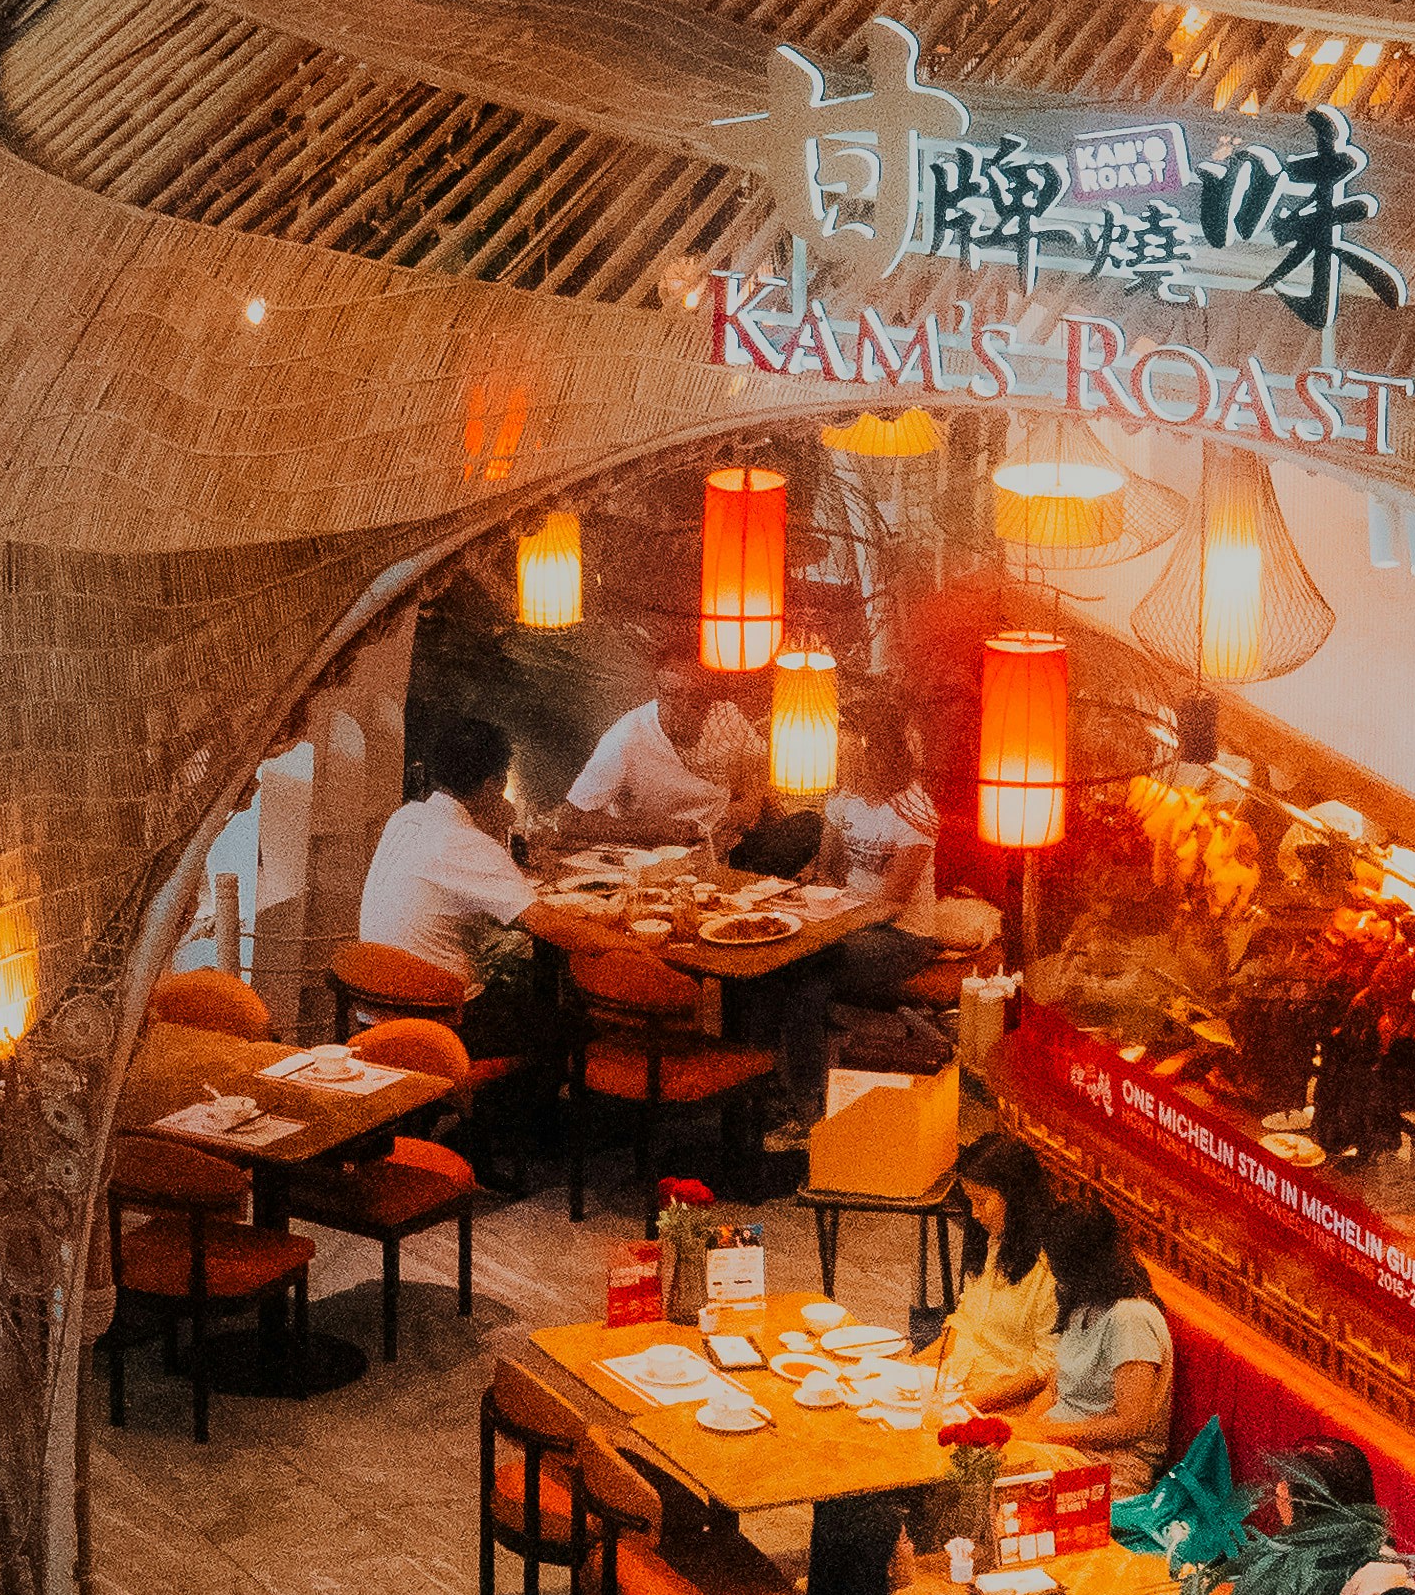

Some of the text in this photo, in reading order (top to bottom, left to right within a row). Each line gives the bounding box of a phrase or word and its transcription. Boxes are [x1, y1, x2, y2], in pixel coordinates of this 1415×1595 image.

[1079, 161, 1166, 192] ROAST
[709, 270, 1415, 456] KAM'S ROAST
[1122, 1079, 1155, 1119] ONE
[1158, 1100, 1234, 1169] MICHELIN
[1237, 1151, 1277, 1196] STAR
[1281, 1178, 1298, 1209] IN
[1302, 1190, 1382, 1263] MICHELIN
